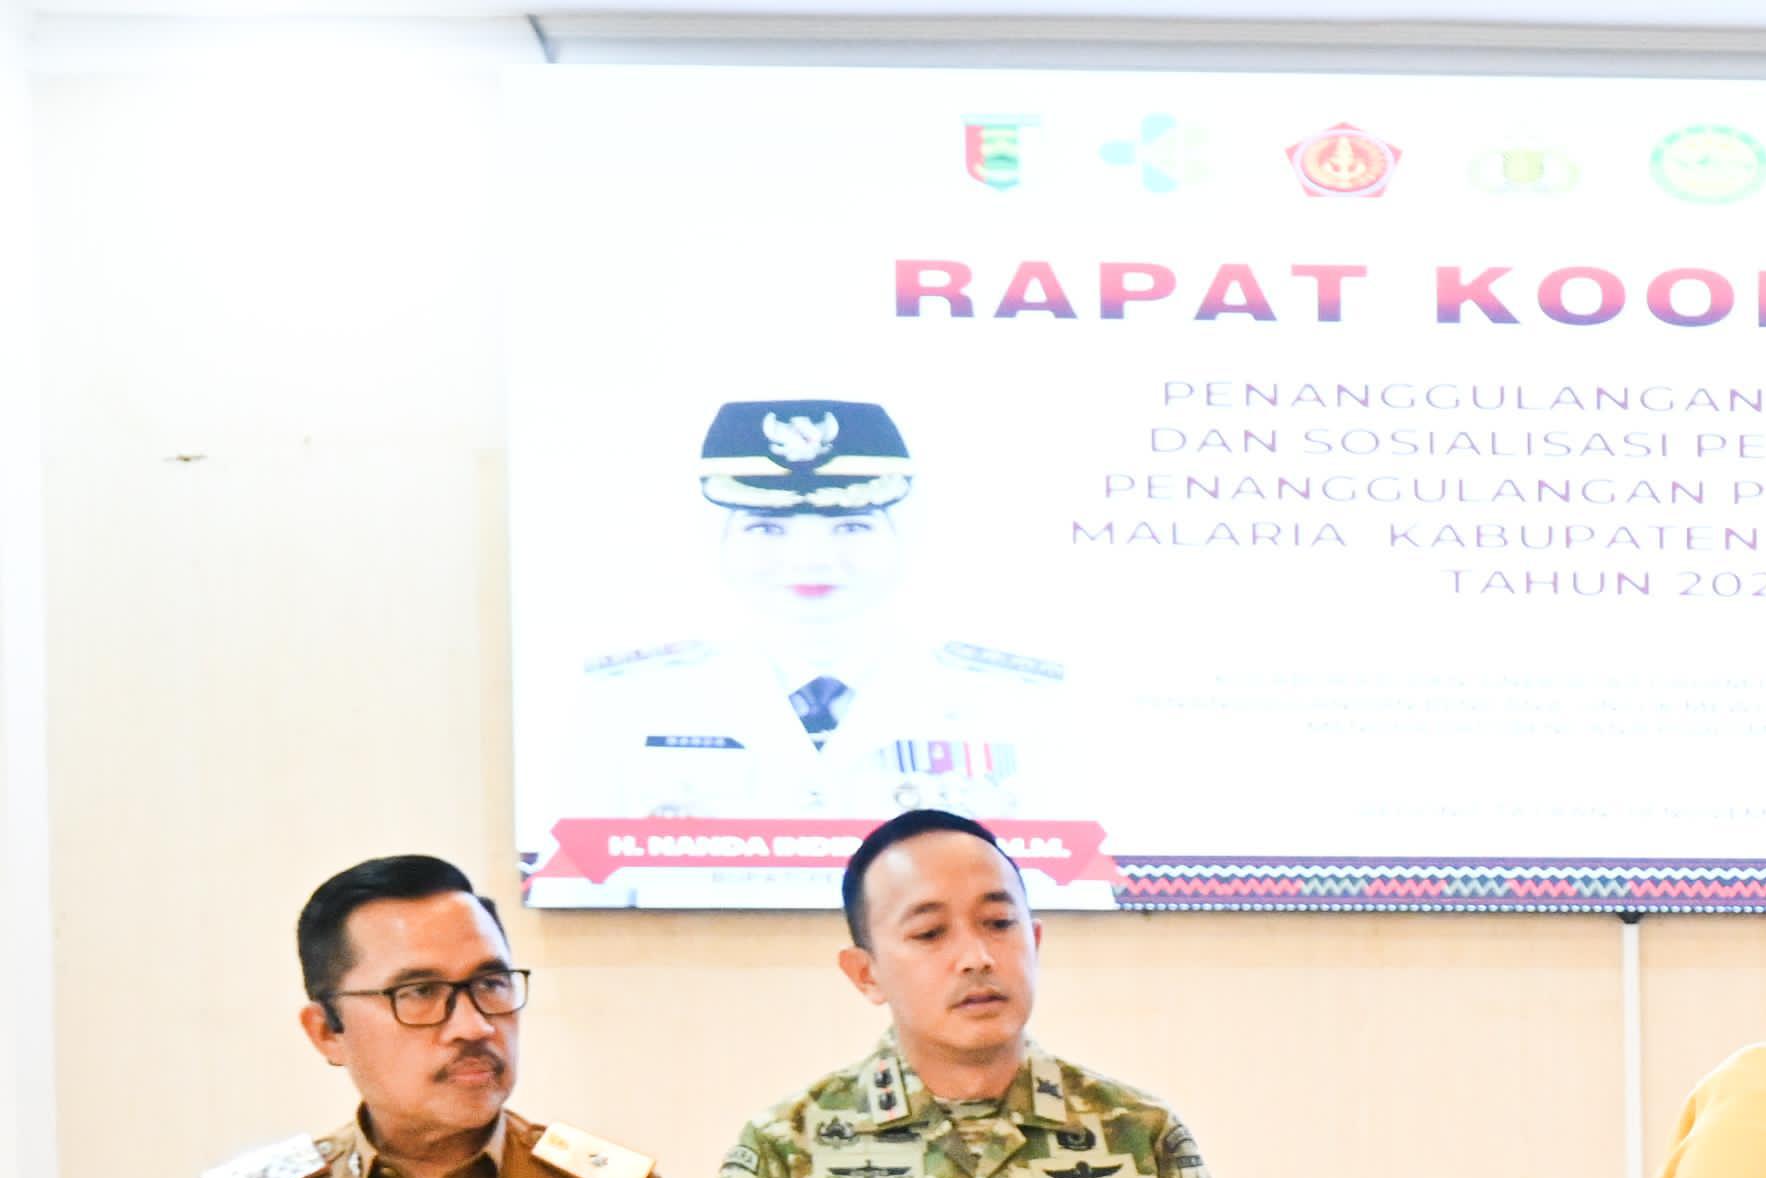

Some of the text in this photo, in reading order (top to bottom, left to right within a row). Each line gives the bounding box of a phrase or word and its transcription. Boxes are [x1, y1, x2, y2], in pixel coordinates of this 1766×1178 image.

[894, 258, 1369, 324] RAPAT
[1163, 380, 1763, 414] PENANGGULANGAN
[1150, 426, 1278, 455] DAN
[1303, 428, 1668, 458] SOSIALISASI
[1104, 473, 1705, 506] PENANGGULANGAN
[1071, 519, 1348, 548] MALARIA
[1389, 522, 1759, 552] KABUPATEN
[1447, 569, 1651, 597] TAHUN
